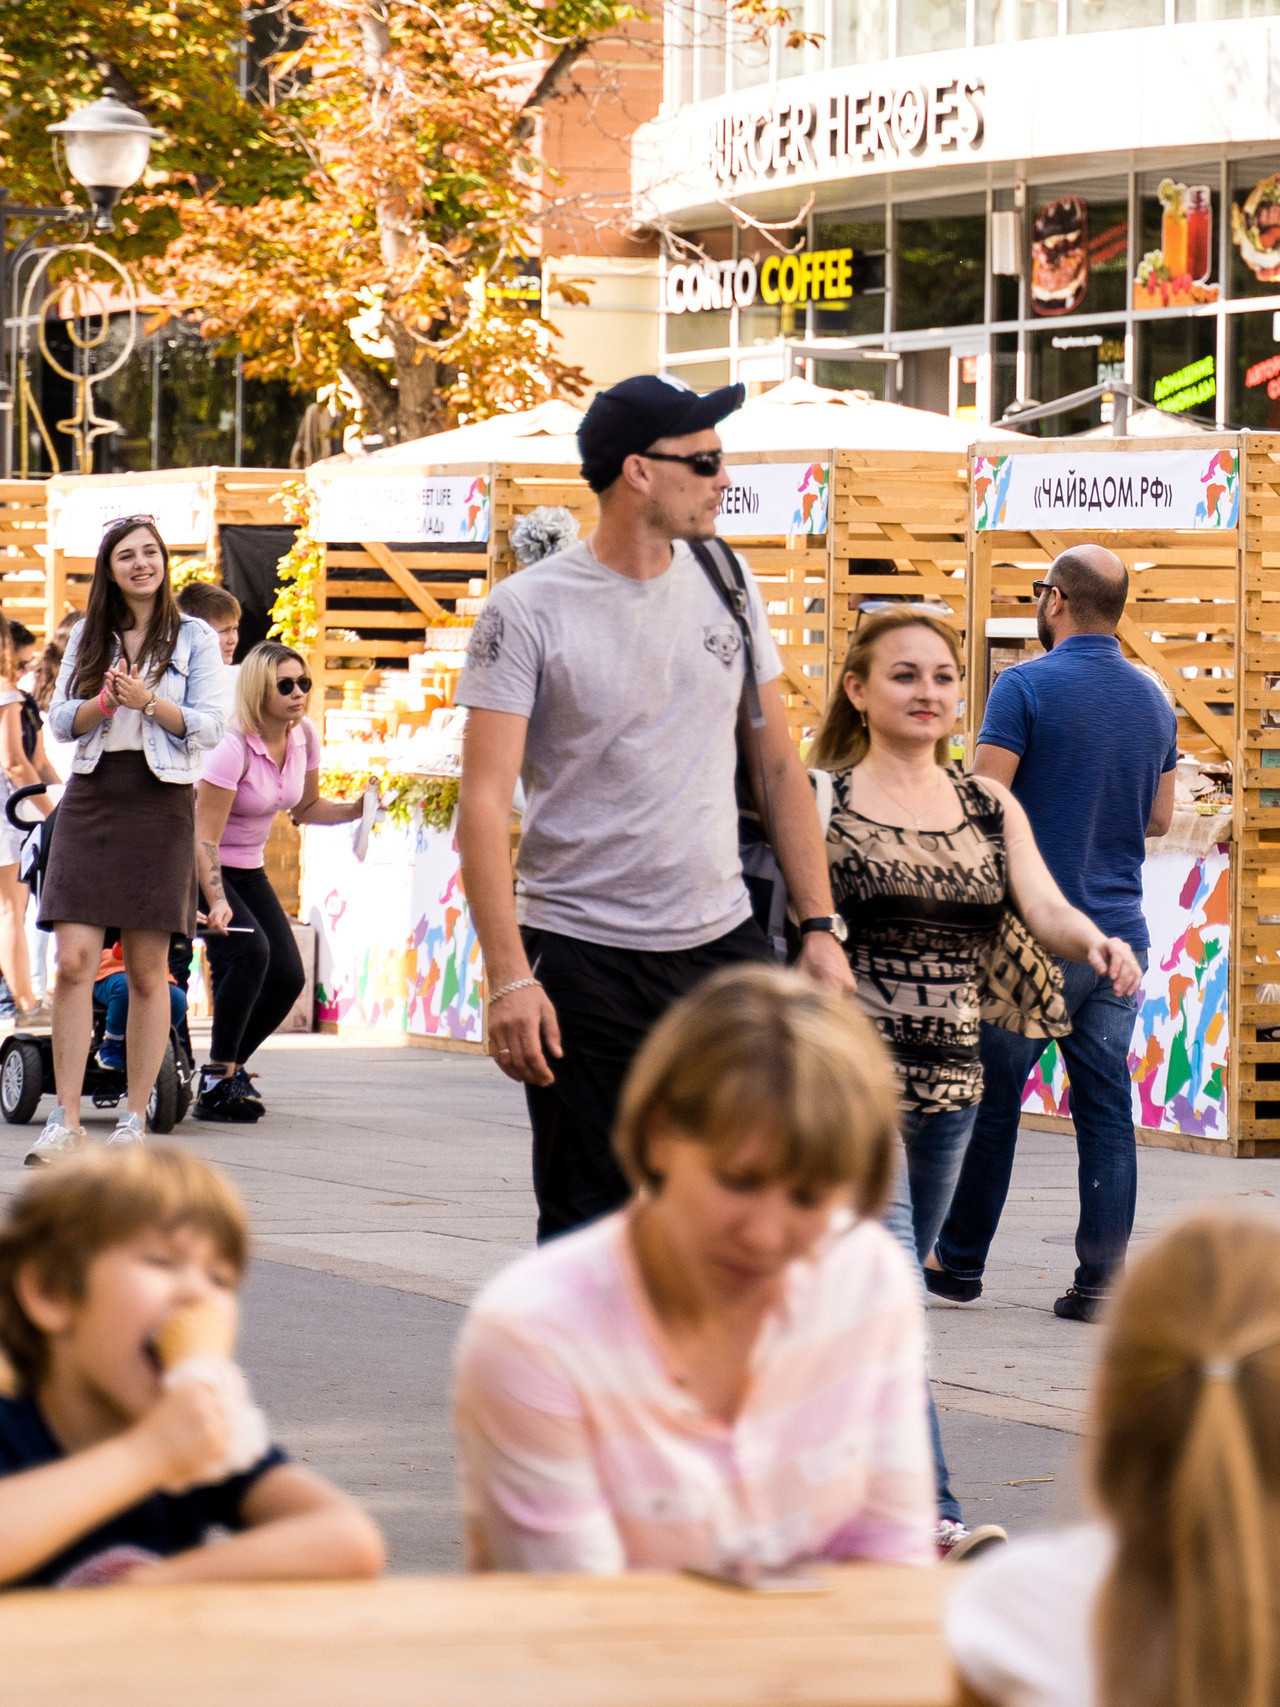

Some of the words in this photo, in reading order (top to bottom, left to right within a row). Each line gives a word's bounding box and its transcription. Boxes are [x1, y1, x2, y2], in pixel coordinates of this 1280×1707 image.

[828, 77, 986, 163] HEROES
[760, 247, 853, 304] COFFEE
[1034, 469, 1172, 512] «ЧАЙВДОМ.РФ»
